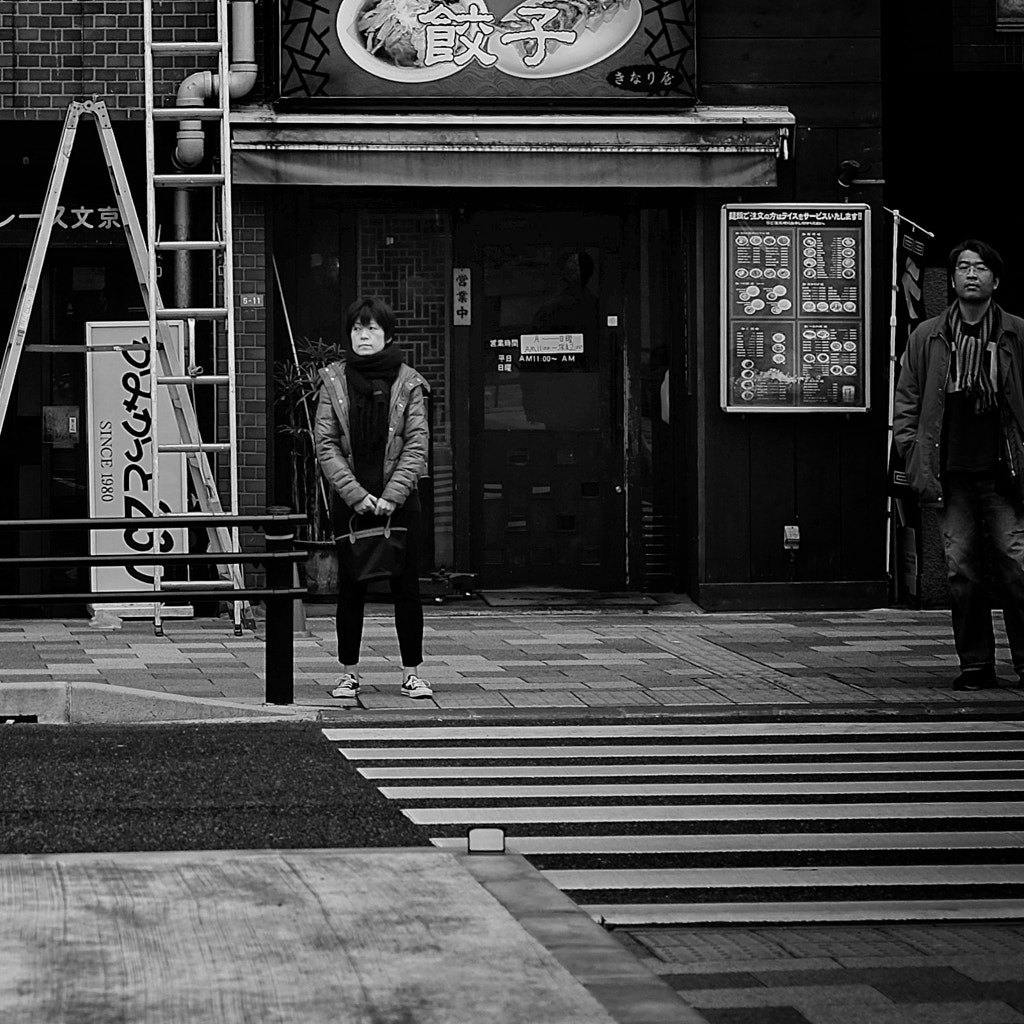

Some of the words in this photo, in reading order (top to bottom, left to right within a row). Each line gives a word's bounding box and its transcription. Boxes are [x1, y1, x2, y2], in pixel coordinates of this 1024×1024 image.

[418, 4, 577, 67] 餃子
[242, 296, 261, 305] 5-11
[455, 273, 469, 319] 営業中
[498, 354, 512, 363] 平日
[99, 420, 113, 468] SINCE
[101, 473, 114, 503] 1980
